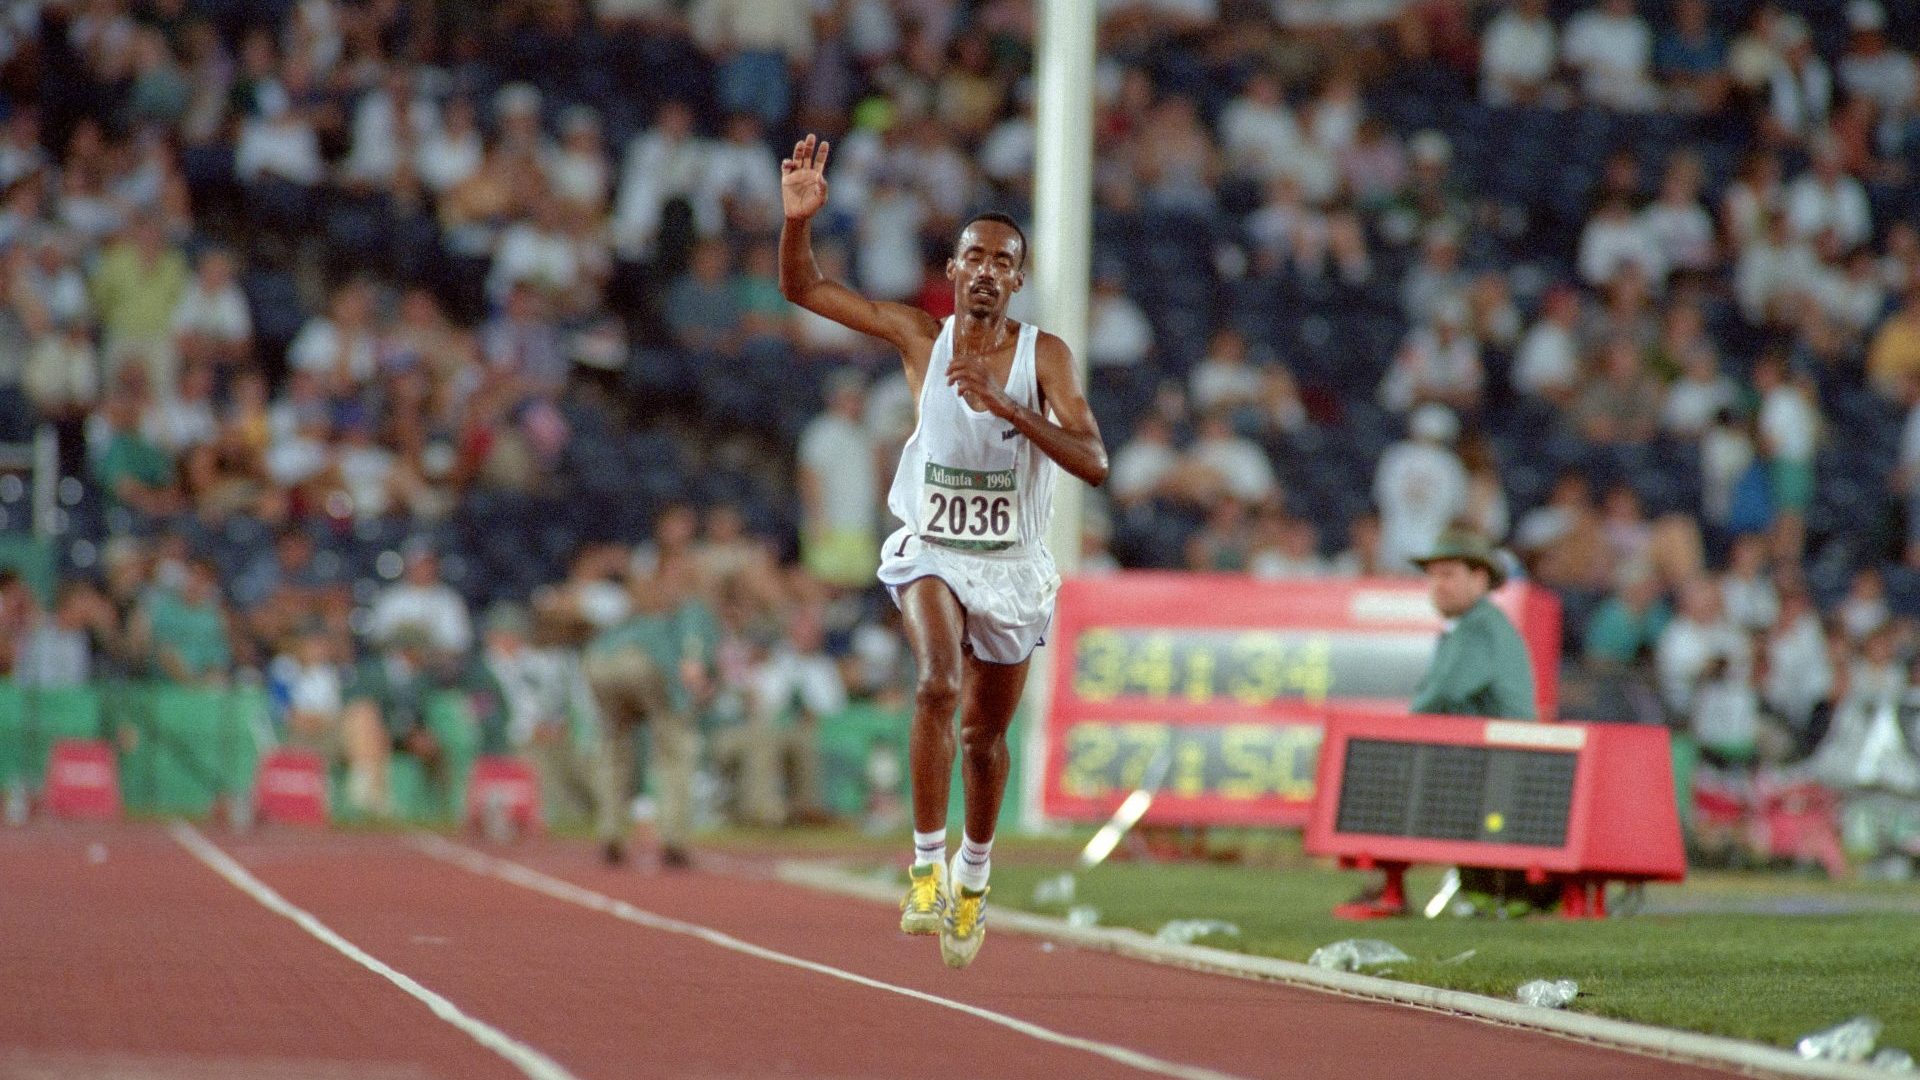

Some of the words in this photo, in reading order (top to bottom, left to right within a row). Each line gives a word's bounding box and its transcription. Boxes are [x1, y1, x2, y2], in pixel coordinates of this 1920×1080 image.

[930, 467, 972, 486] Atlanta
[986, 473, 1012, 488] 1996
[927, 492, 1010, 536] 2036
[1073, 628, 1330, 702] 34:34
